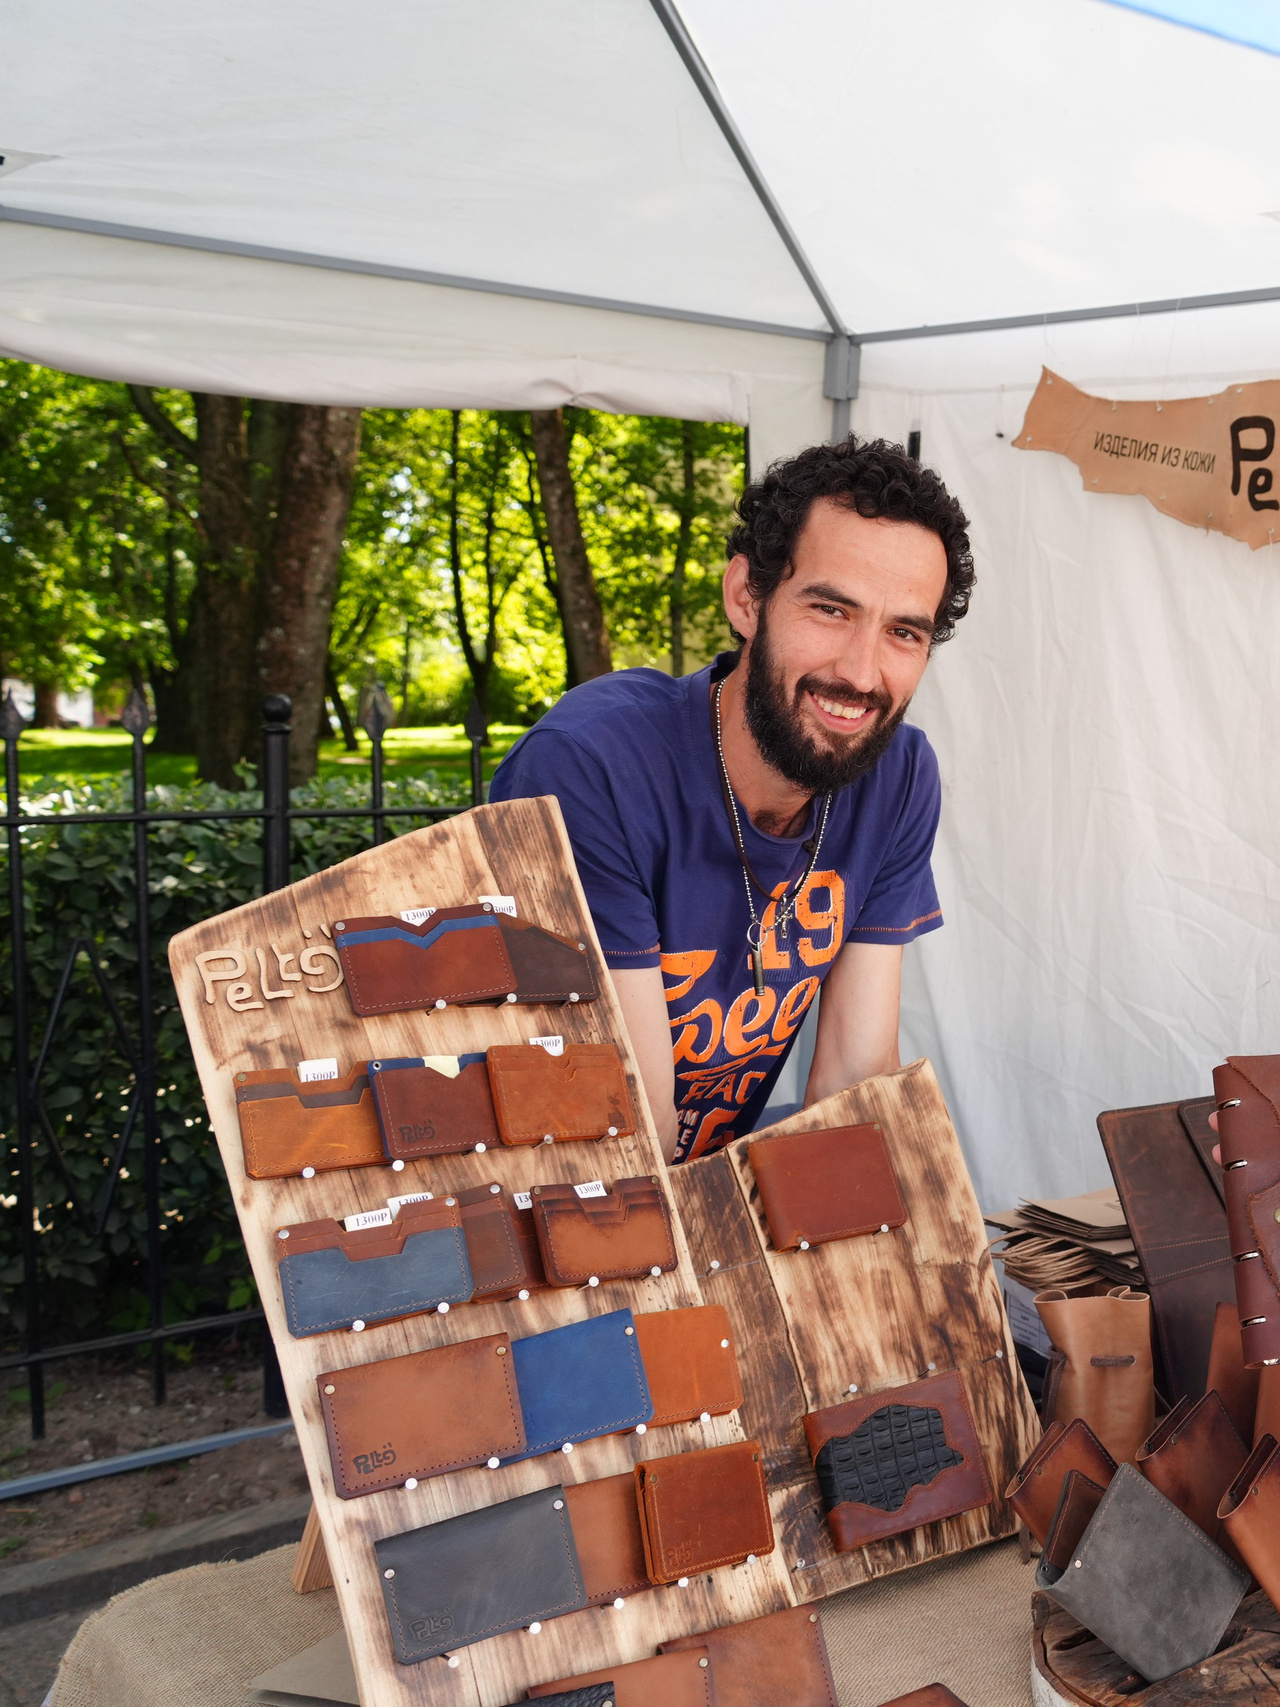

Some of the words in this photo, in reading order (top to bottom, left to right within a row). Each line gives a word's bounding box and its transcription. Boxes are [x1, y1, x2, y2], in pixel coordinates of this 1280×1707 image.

[1093, 431, 1159, 463] ИЗДЕЛИЯ
[1160, 445, 1181, 467] ИЗ
[1181, 449, 1217, 474] КОЖИ
